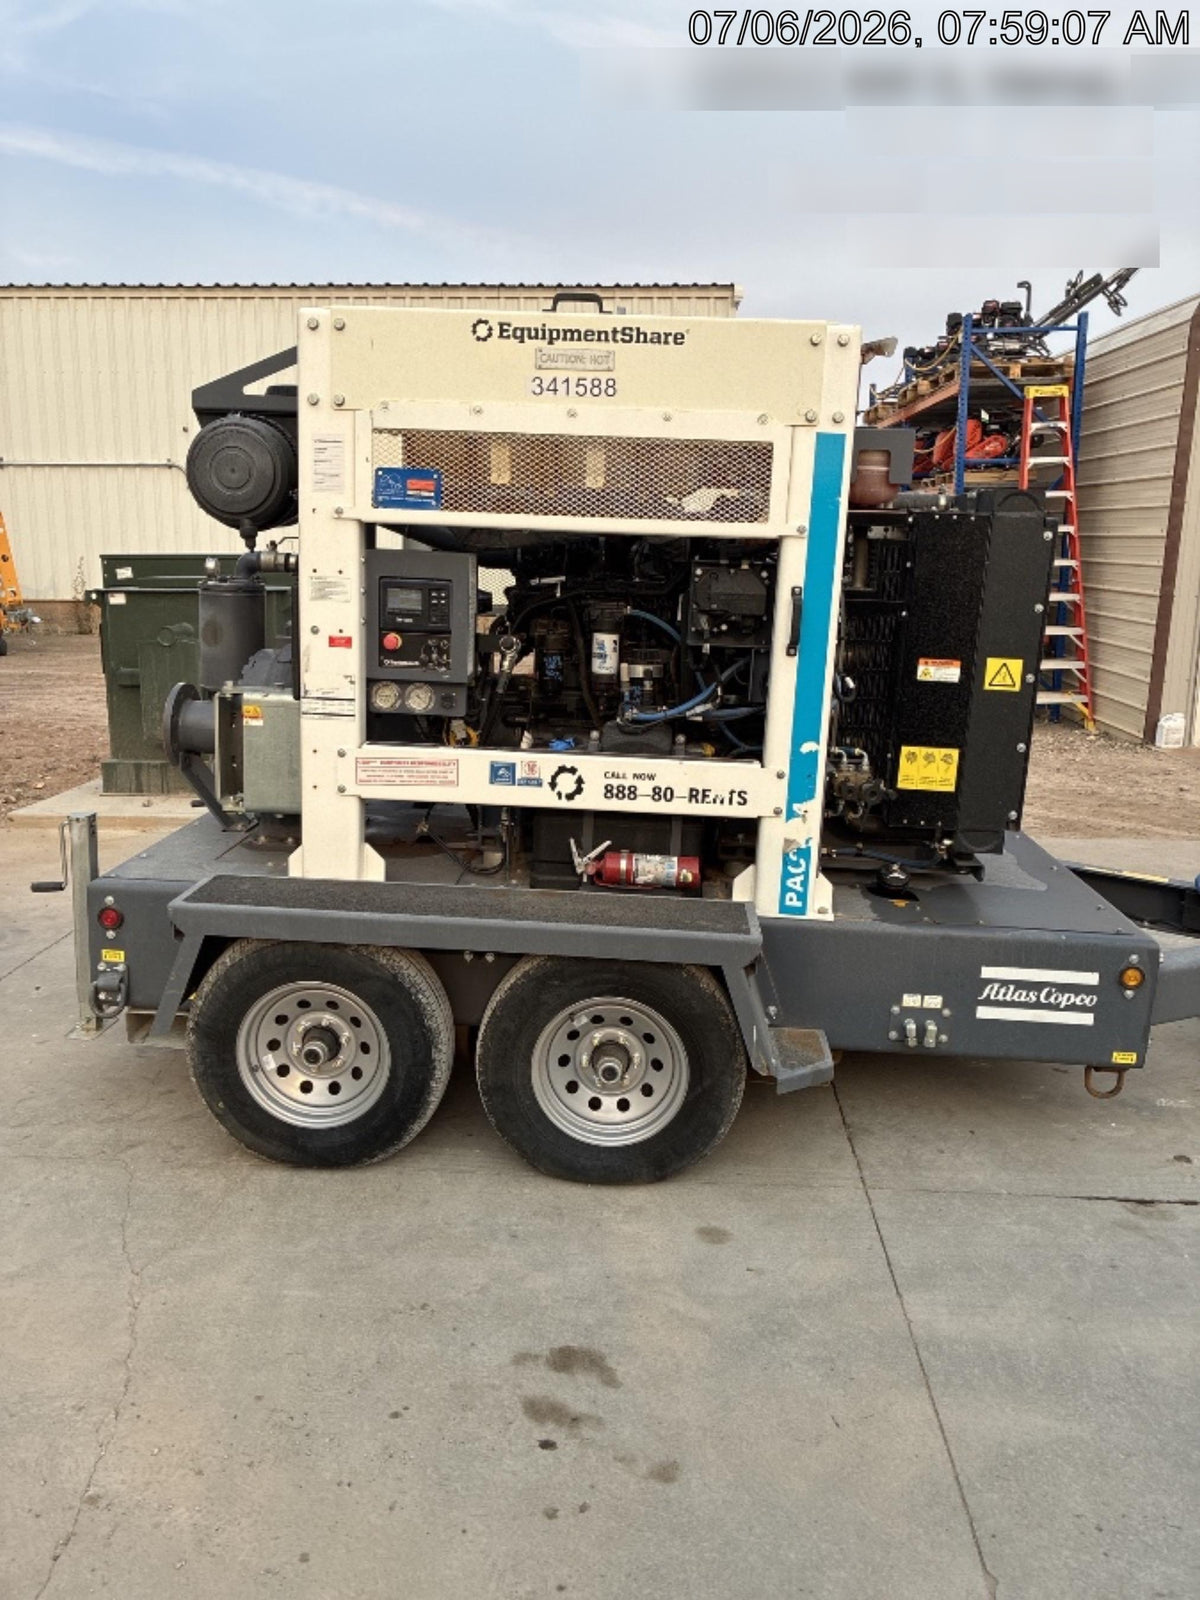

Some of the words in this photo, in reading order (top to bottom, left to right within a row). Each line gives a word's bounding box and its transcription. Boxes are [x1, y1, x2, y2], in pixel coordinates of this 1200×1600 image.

[498, 322, 686, 346] EquipmentShare
[531, 376, 617, 397] 341588
[604, 770, 628, 780] CALL
[632, 771, 656, 782] NOW
[977, 982, 1038, 1005] Atlas
[1038, 986, 1098, 1009] Copco
